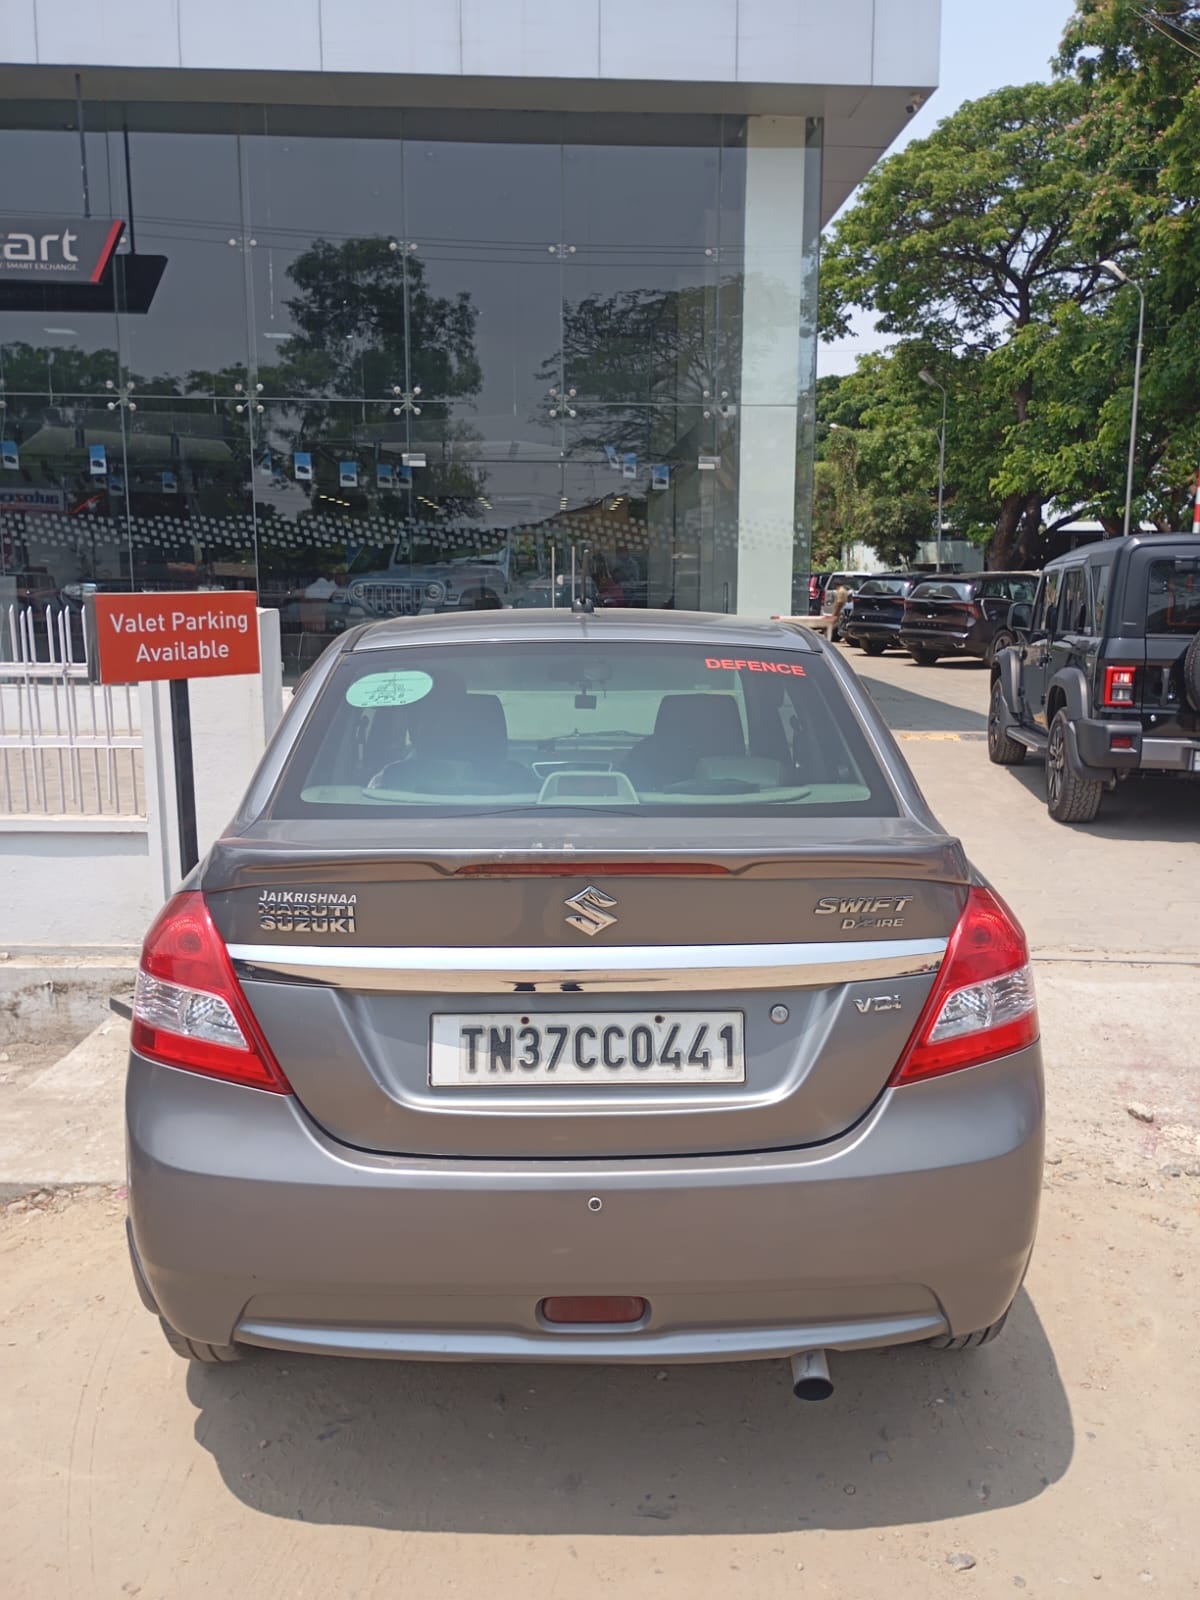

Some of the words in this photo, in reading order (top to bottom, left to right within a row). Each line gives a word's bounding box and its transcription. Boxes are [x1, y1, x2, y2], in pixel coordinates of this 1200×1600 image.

[0, 228, 79, 262] art
[6, 262, 33, 270] SMART
[109, 612, 165, 634] Valet
[171, 610, 249, 633] Parking
[136, 640, 230, 664] Available
[704, 658, 807, 677] DEFENCE
[259, 890, 357, 904] JAIKRISHNAA
[815, 895, 914, 915] SWIFT
[258, 902, 355, 917] MARUTI
[259, 915, 356, 933] SUZUKI
[461, 1023, 735, 1073] TN37CC0441
